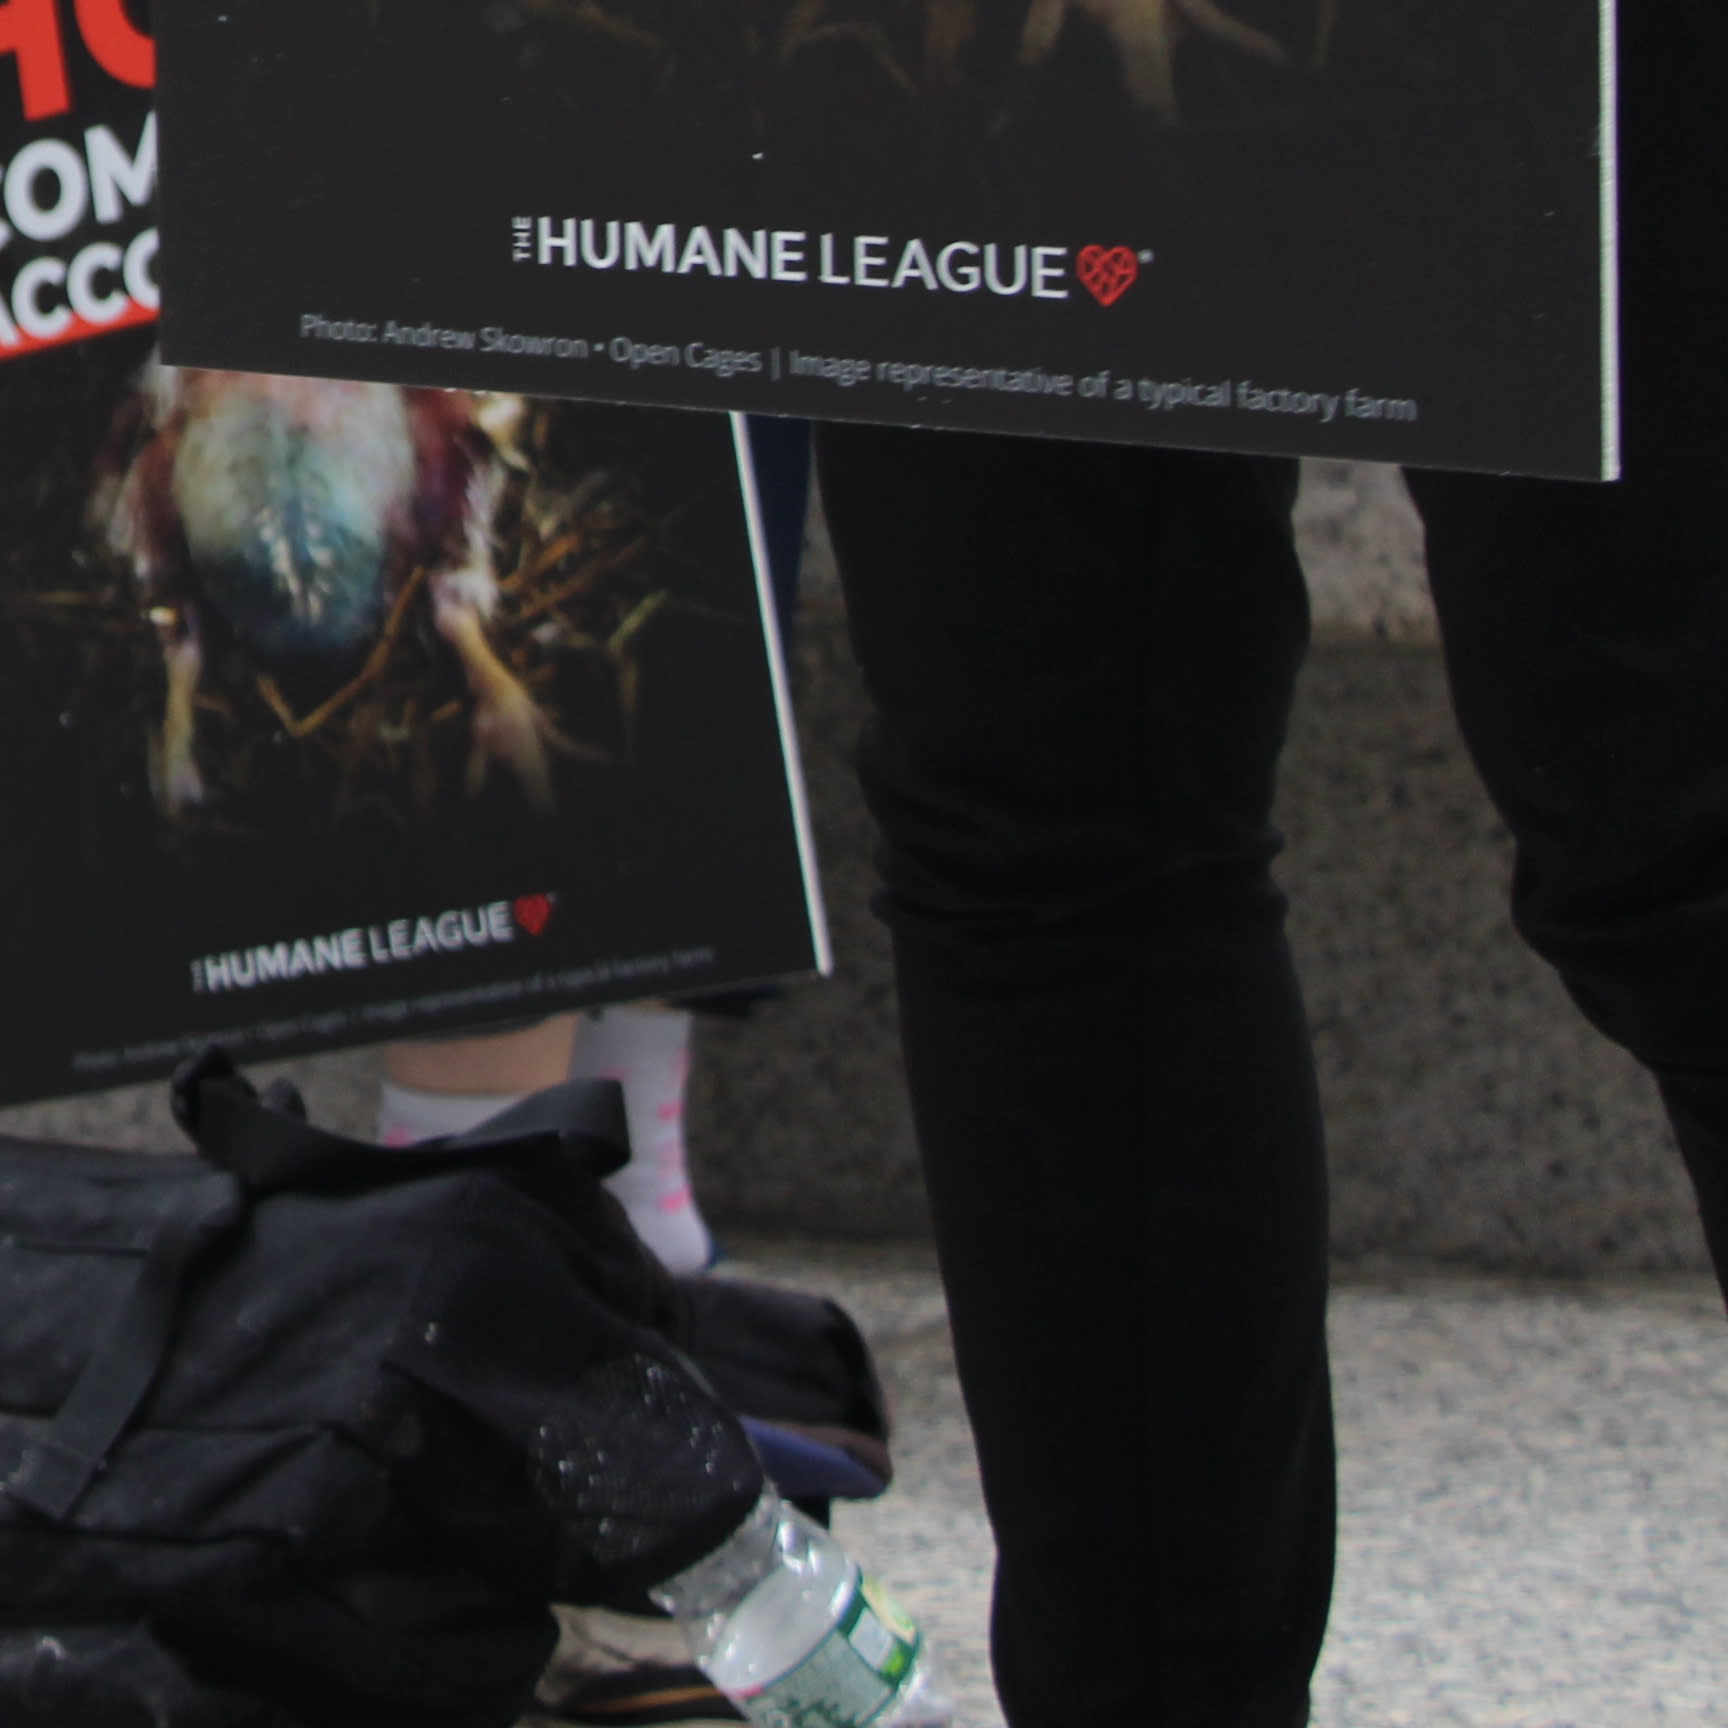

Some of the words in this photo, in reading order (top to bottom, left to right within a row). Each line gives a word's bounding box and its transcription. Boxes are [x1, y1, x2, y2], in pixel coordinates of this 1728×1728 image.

[511, 215, 533, 262] THE
[536, 216, 807, 282] HUMANE
[818, 232, 1070, 300] LEAGUE
[300, 314, 377, 343] Photo:
[381, 319, 477, 351] Andrew
[479, 327, 589, 360] Skowron
[609, 336, 679, 369] Open
[685, 342, 762, 377] Cages
[790, 350, 872, 386] Image
[877, 361, 1073, 396] representative
[1077, 369, 1111, 398] of
[1113, 378, 1132, 400] a
[1137, 378, 1232, 410] typical
[1236, 380, 1341, 423] factory
[1345, 387, 1418, 422] farm
[204, 928, 368, 992] HUMANE
[370, 899, 514, 964] LEAGUE
